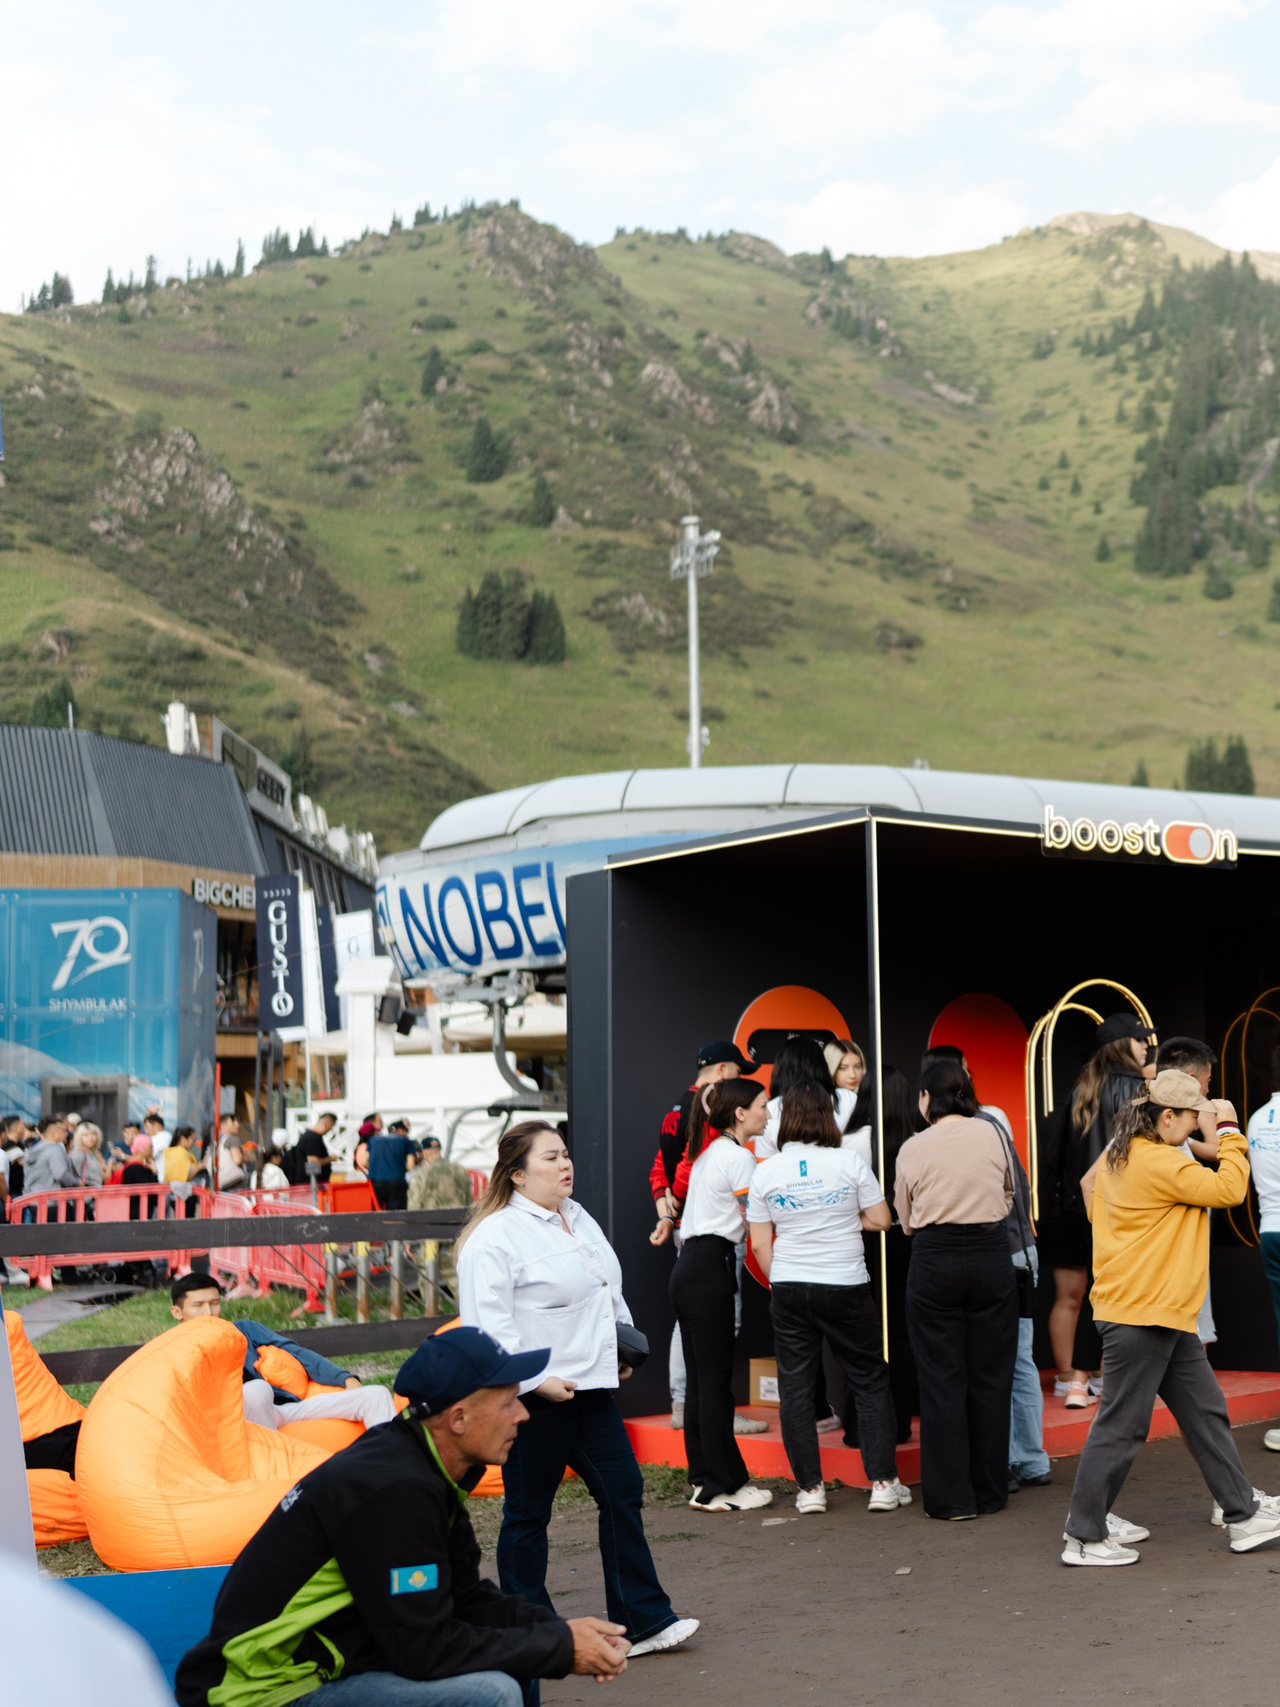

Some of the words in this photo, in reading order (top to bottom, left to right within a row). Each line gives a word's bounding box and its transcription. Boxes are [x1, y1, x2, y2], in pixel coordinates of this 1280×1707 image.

[194, 878, 256, 910] BIGCHE
[268, 900, 294, 1017] GUSTO
[49, 998, 127, 1012] SHYMBULAK
